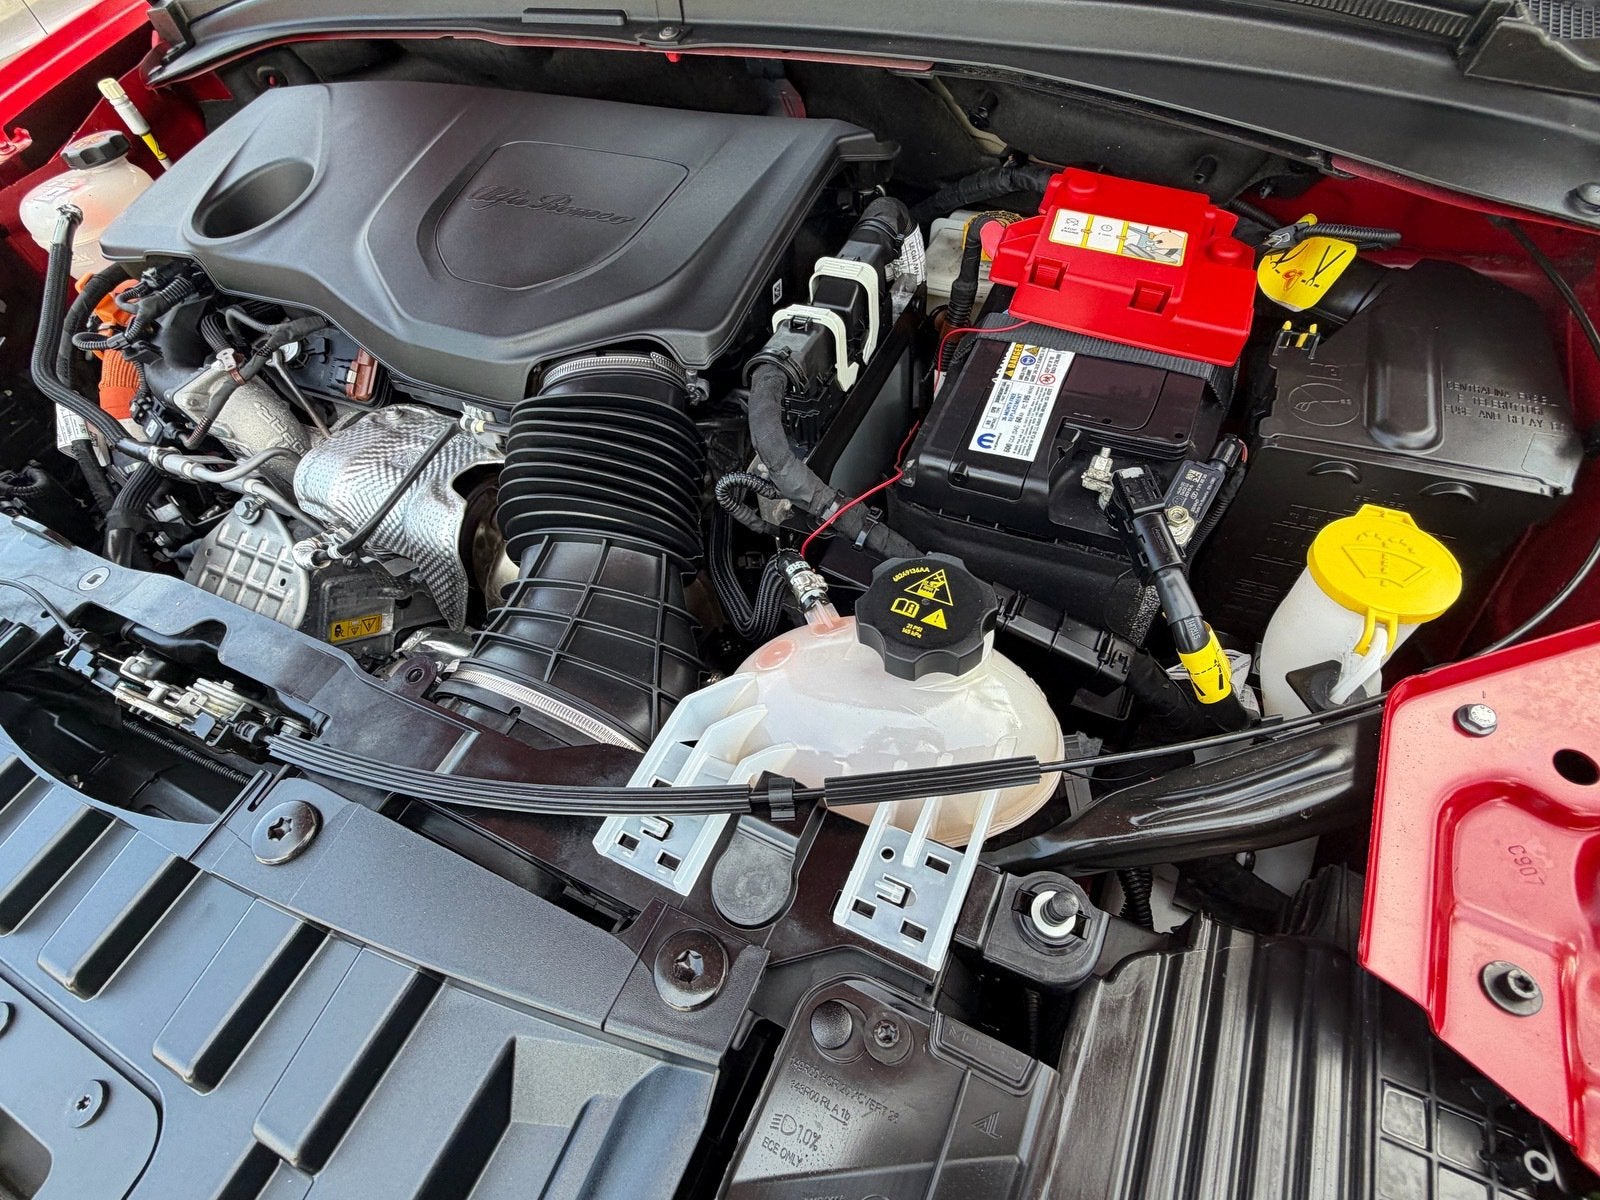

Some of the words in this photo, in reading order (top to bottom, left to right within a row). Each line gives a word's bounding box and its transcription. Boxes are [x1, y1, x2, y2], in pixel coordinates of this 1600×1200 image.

[466, 184, 531, 211] Alfa
[528, 193, 637, 225] Romeo
[1008, 343, 1025, 369] DANGER
[1444, 403, 1471, 416] FUSE
[1508, 845, 1544, 885] C907
[762, 1136, 780, 1155] ECE
[779, 1147, 803, 1168] ONLY
